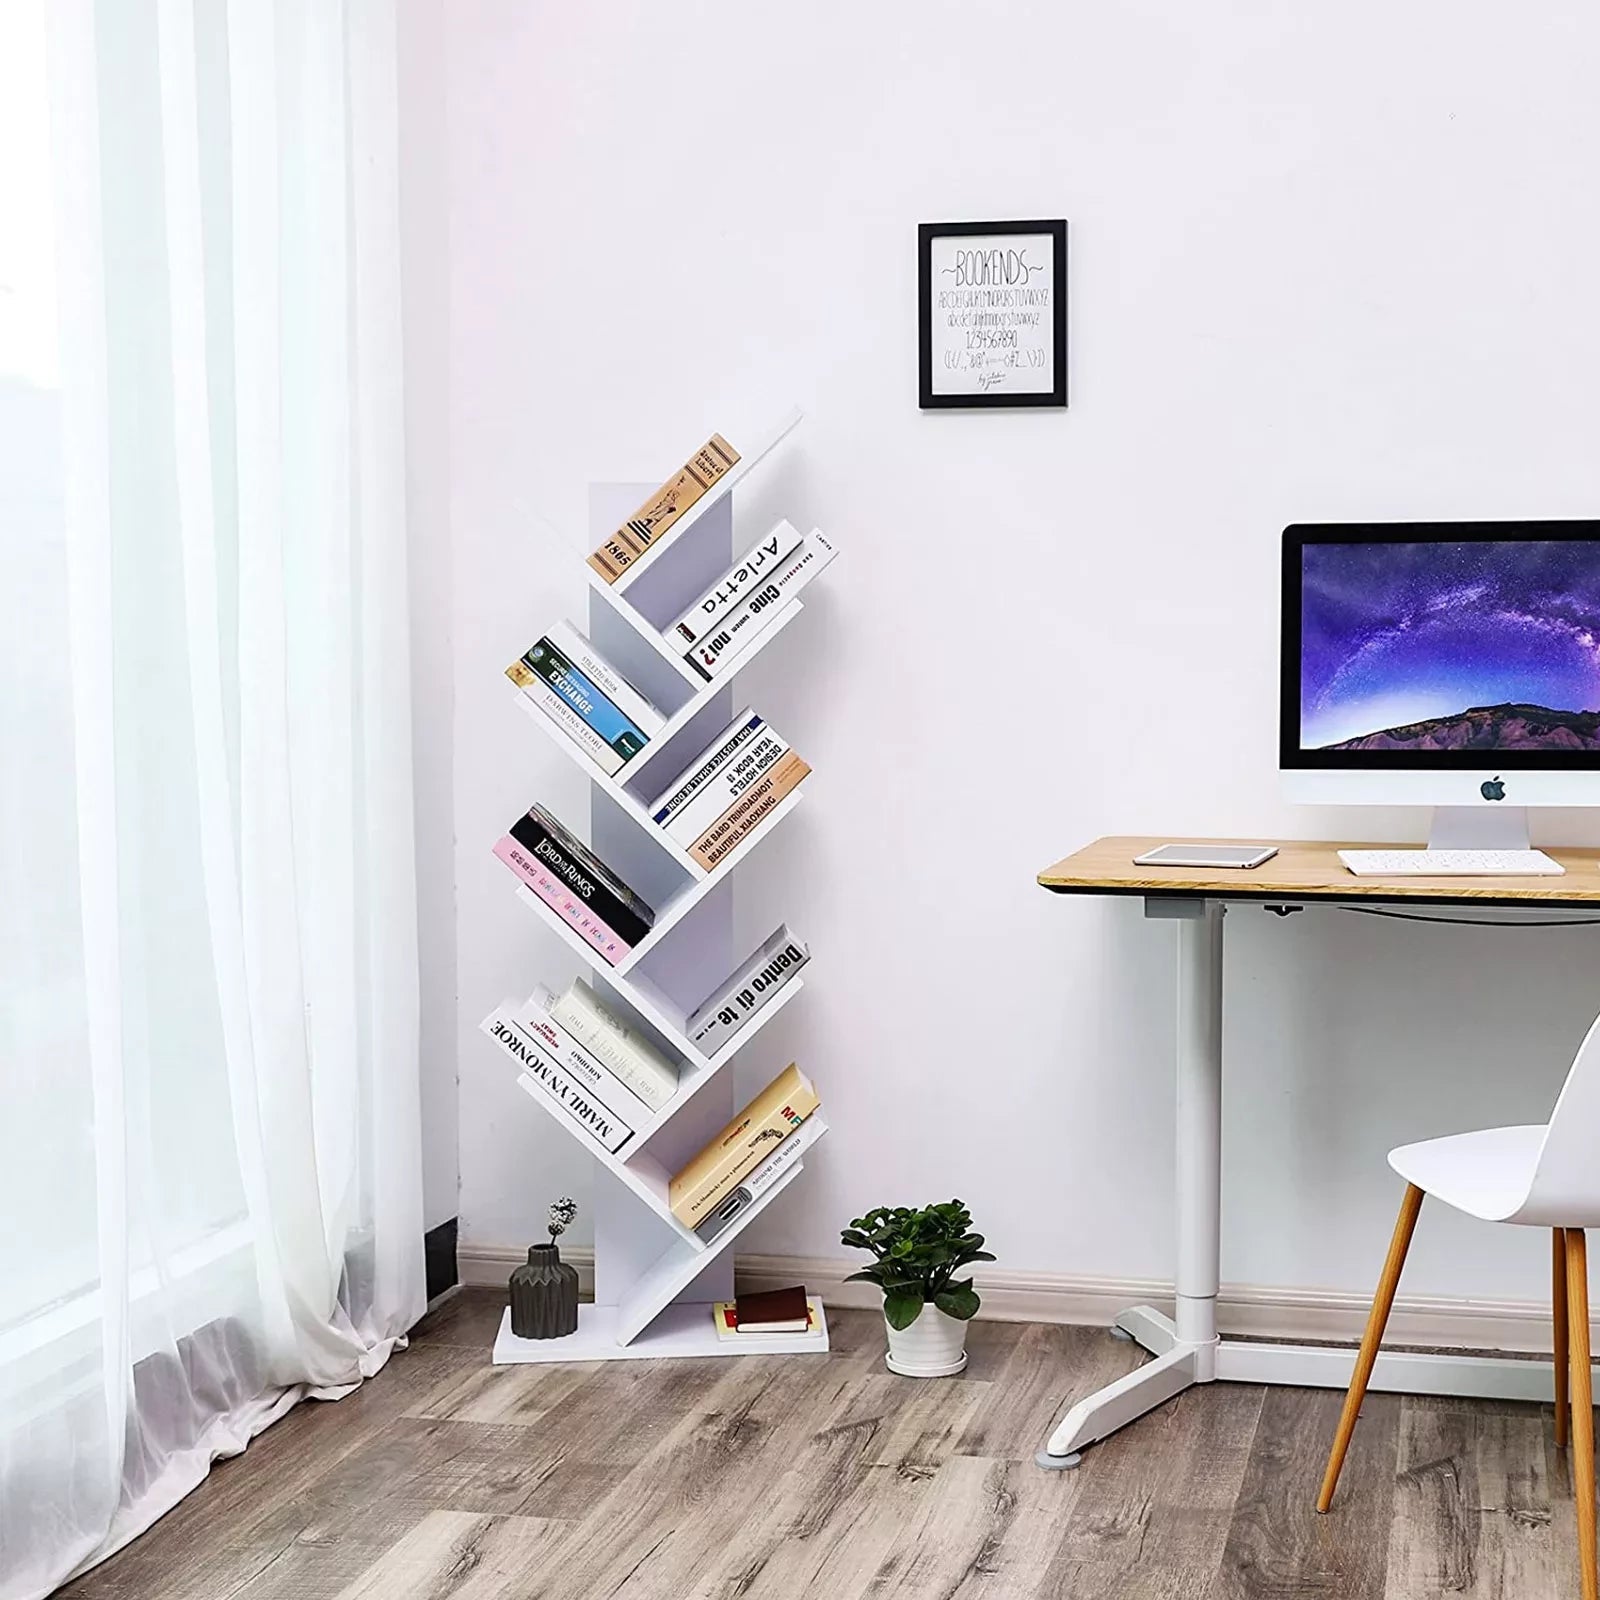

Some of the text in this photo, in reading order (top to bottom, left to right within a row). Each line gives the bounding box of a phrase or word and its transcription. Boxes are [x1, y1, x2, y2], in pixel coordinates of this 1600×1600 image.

[966, 329, 1018, 349] 1234567890
[604, 540, 632, 566] 1865
[701, 536, 778, 614] Arletta
[748, 584, 781, 614] Cine
[699, 630, 732, 666] noi?
[548, 670, 595, 715] EXCHANGE
[664, 725, 754, 813] THAT JUSTICE SHALL BE DONE
[732, 754, 755, 777] BOOK
[751, 736, 774, 758] YEAR
[729, 743, 783, 797] DESIGN HOTELS
[697, 838, 715, 854] THE
[709, 821, 731, 842] BARD
[707, 795, 777, 864] BEAUTIFUL XIAOXIANG
[533, 837, 563, 869] LORD
[561, 864, 596, 898] RINGS
[751, 943, 804, 993] Dentro
[735, 988, 756, 1012] di
[489, 1020, 553, 1081] MONROE
[547, 1075, 613, 1138] MARILYN
